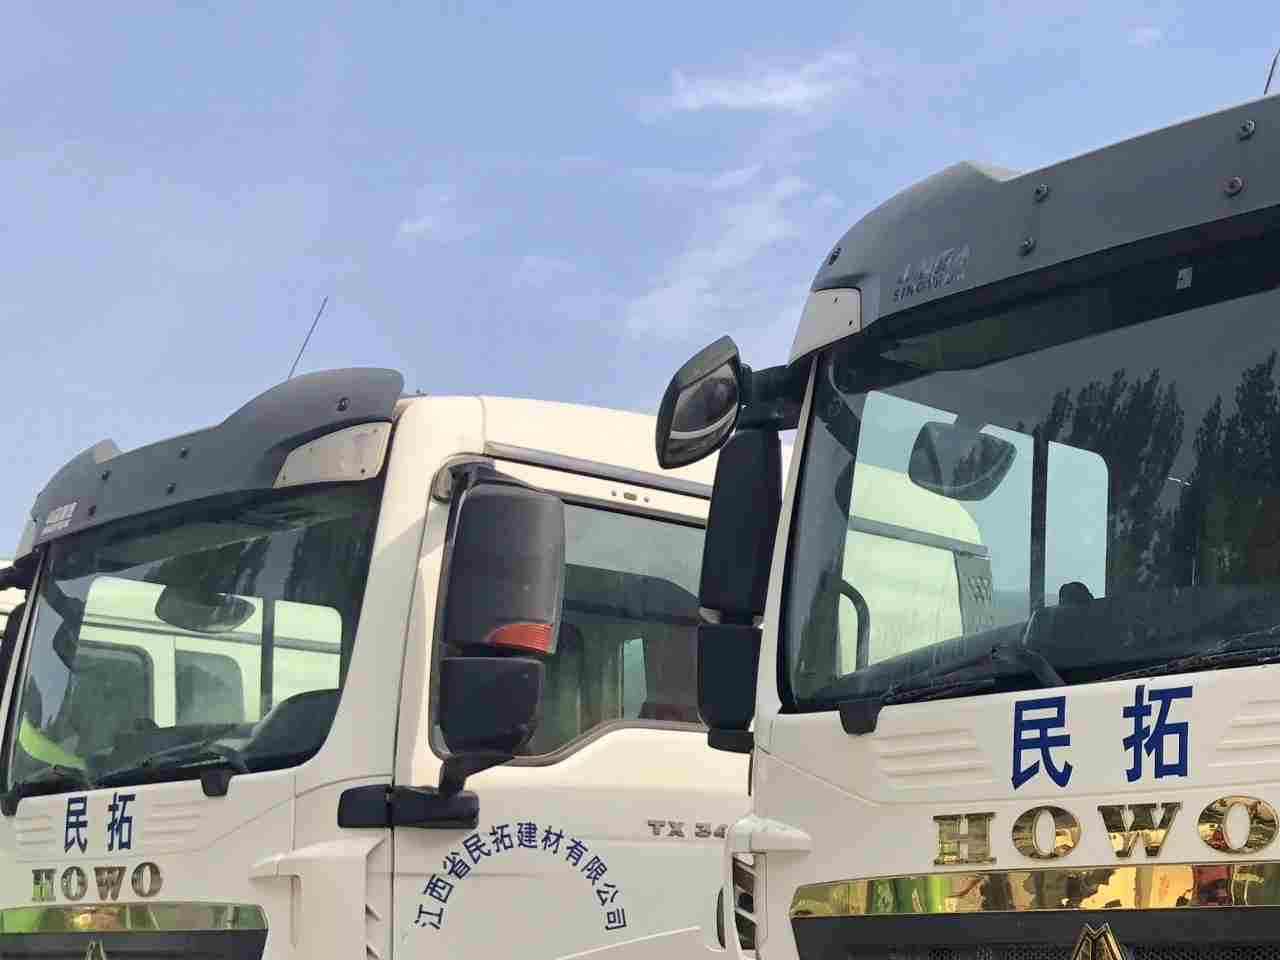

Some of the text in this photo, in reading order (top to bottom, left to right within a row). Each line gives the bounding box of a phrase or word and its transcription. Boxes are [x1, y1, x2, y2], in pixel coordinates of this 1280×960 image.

[695, 822, 729, 839] 34
[932, 795, 1280, 866] HOWO
[32, 861, 164, 902] HOWO
[414, 822, 627, 931] 江西省民拓建材有限公司
